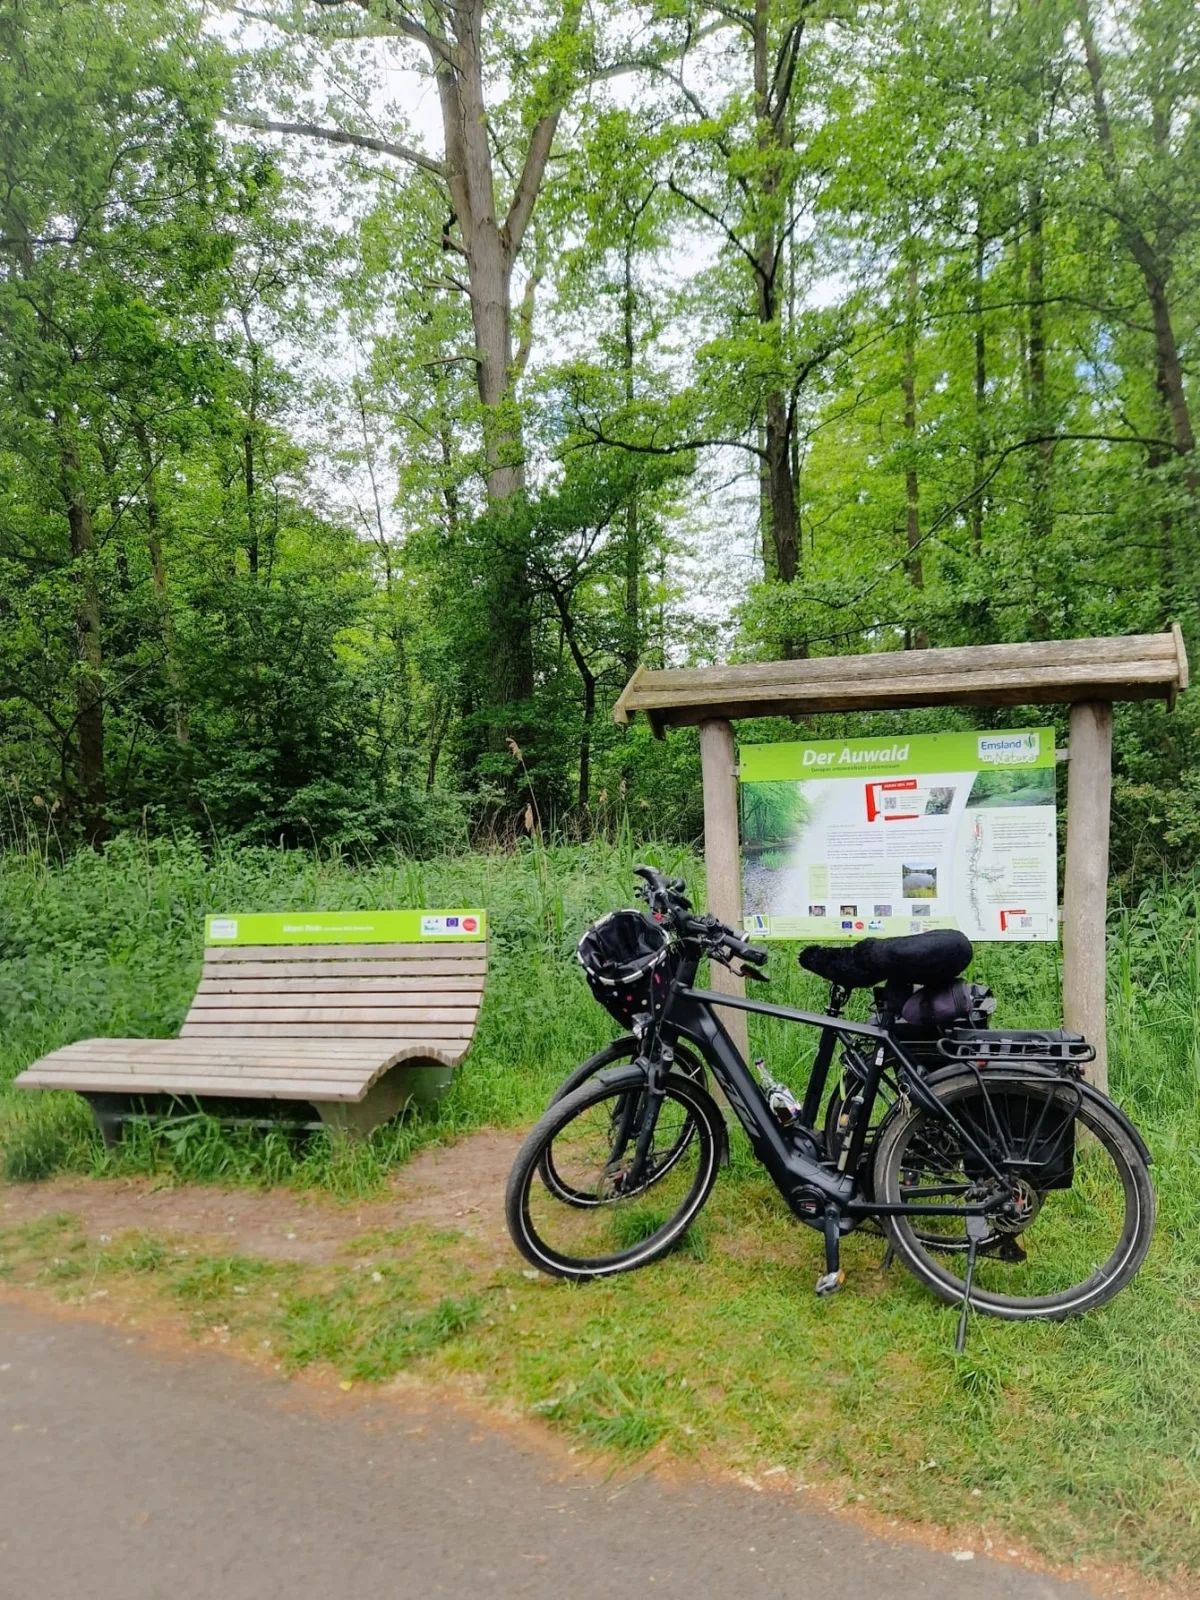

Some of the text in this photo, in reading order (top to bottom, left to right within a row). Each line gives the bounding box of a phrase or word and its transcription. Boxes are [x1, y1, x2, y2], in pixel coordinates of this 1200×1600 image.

[981, 740, 1022, 750] Emsland
[802, 744, 910, 766] Der Auwald
[994, 750, 1036, 763] Natura
